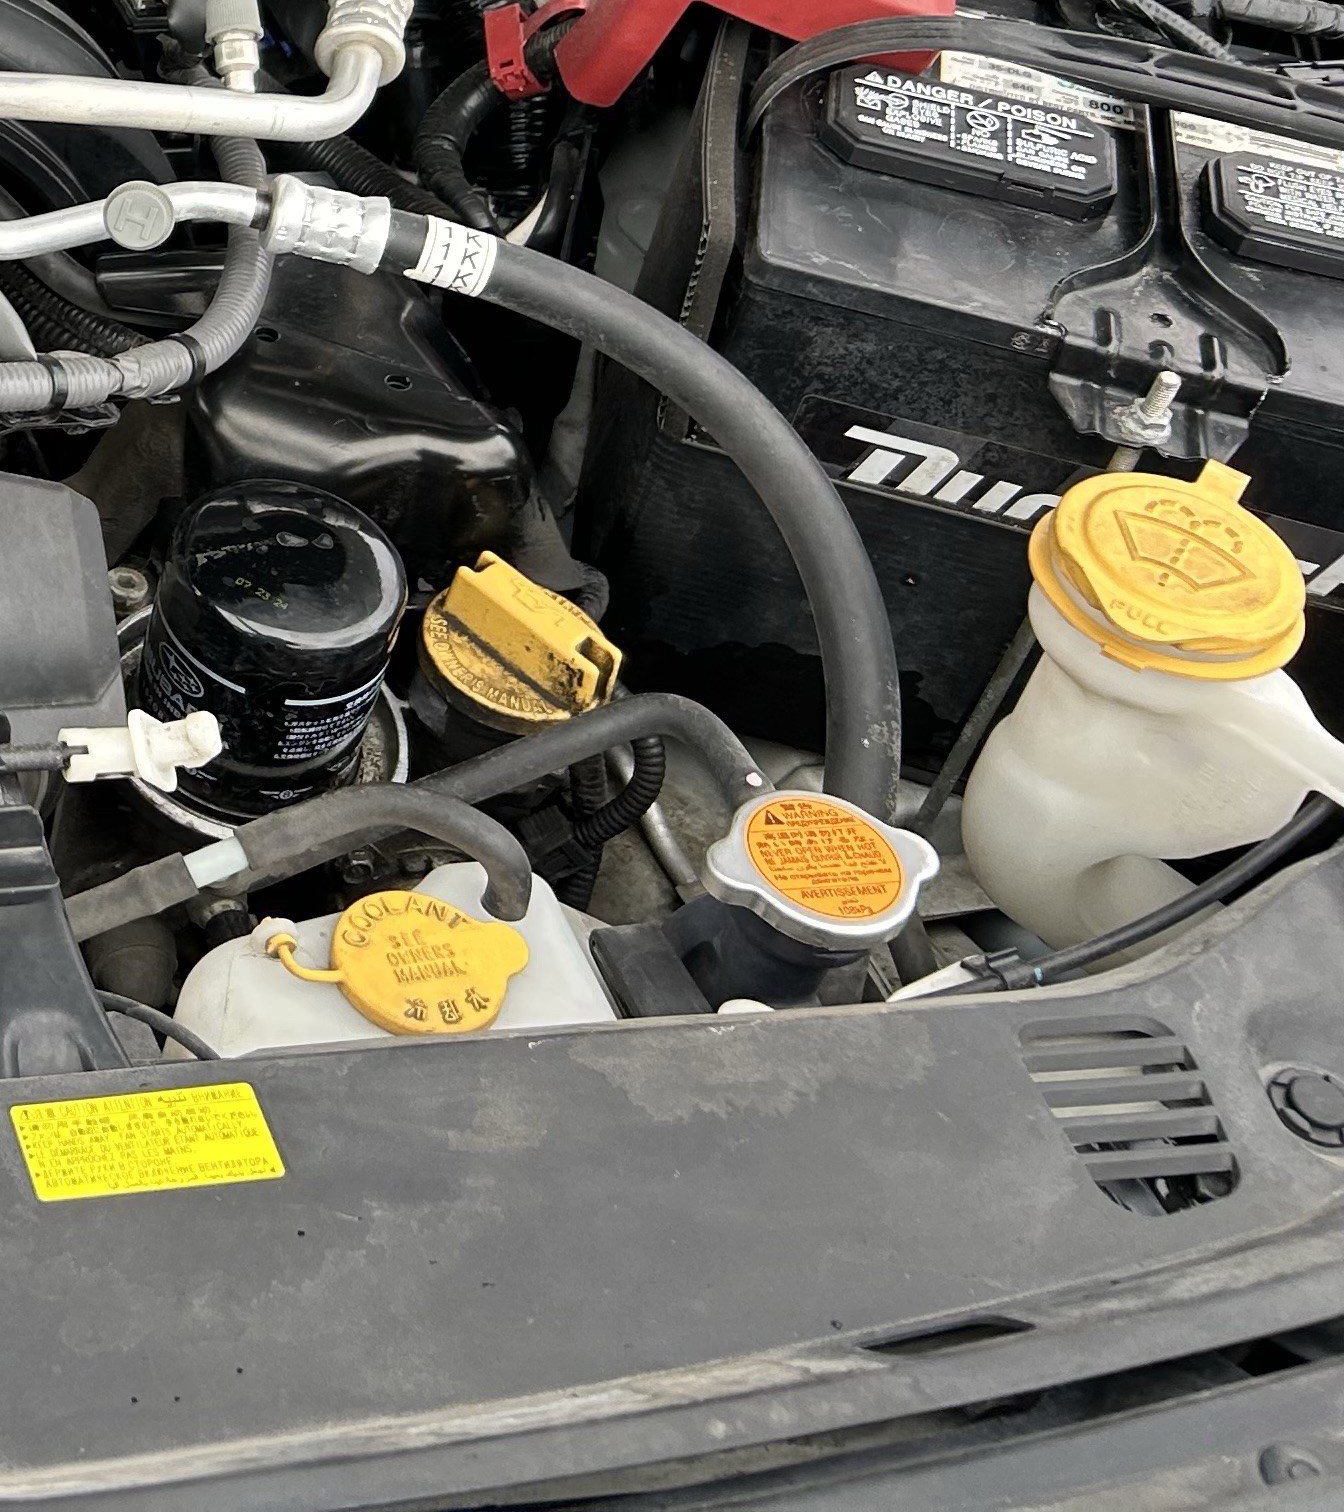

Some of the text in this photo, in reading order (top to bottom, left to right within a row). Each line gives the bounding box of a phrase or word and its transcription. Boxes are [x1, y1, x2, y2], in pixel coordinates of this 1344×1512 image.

[887, 75, 974, 105] DANGER
[997, 101, 1078, 130] POISON
[1088, 99, 1124, 115] 800
[114, 198, 159, 241] H
[235, 577, 252, 588] 07
[255, 587, 272, 600] 23
[429, 616, 448, 640] SEE
[488, 686, 554, 715] MANUAL
[782, 810, 839, 819] WARNING
[801, 884, 888, 900] AVERTISSEMENT
[342, 895, 472, 948] COOLANT
[392, 959, 467, 984] MANUAL
[58, 1096, 153, 1116] CAUTION ATTENTION
